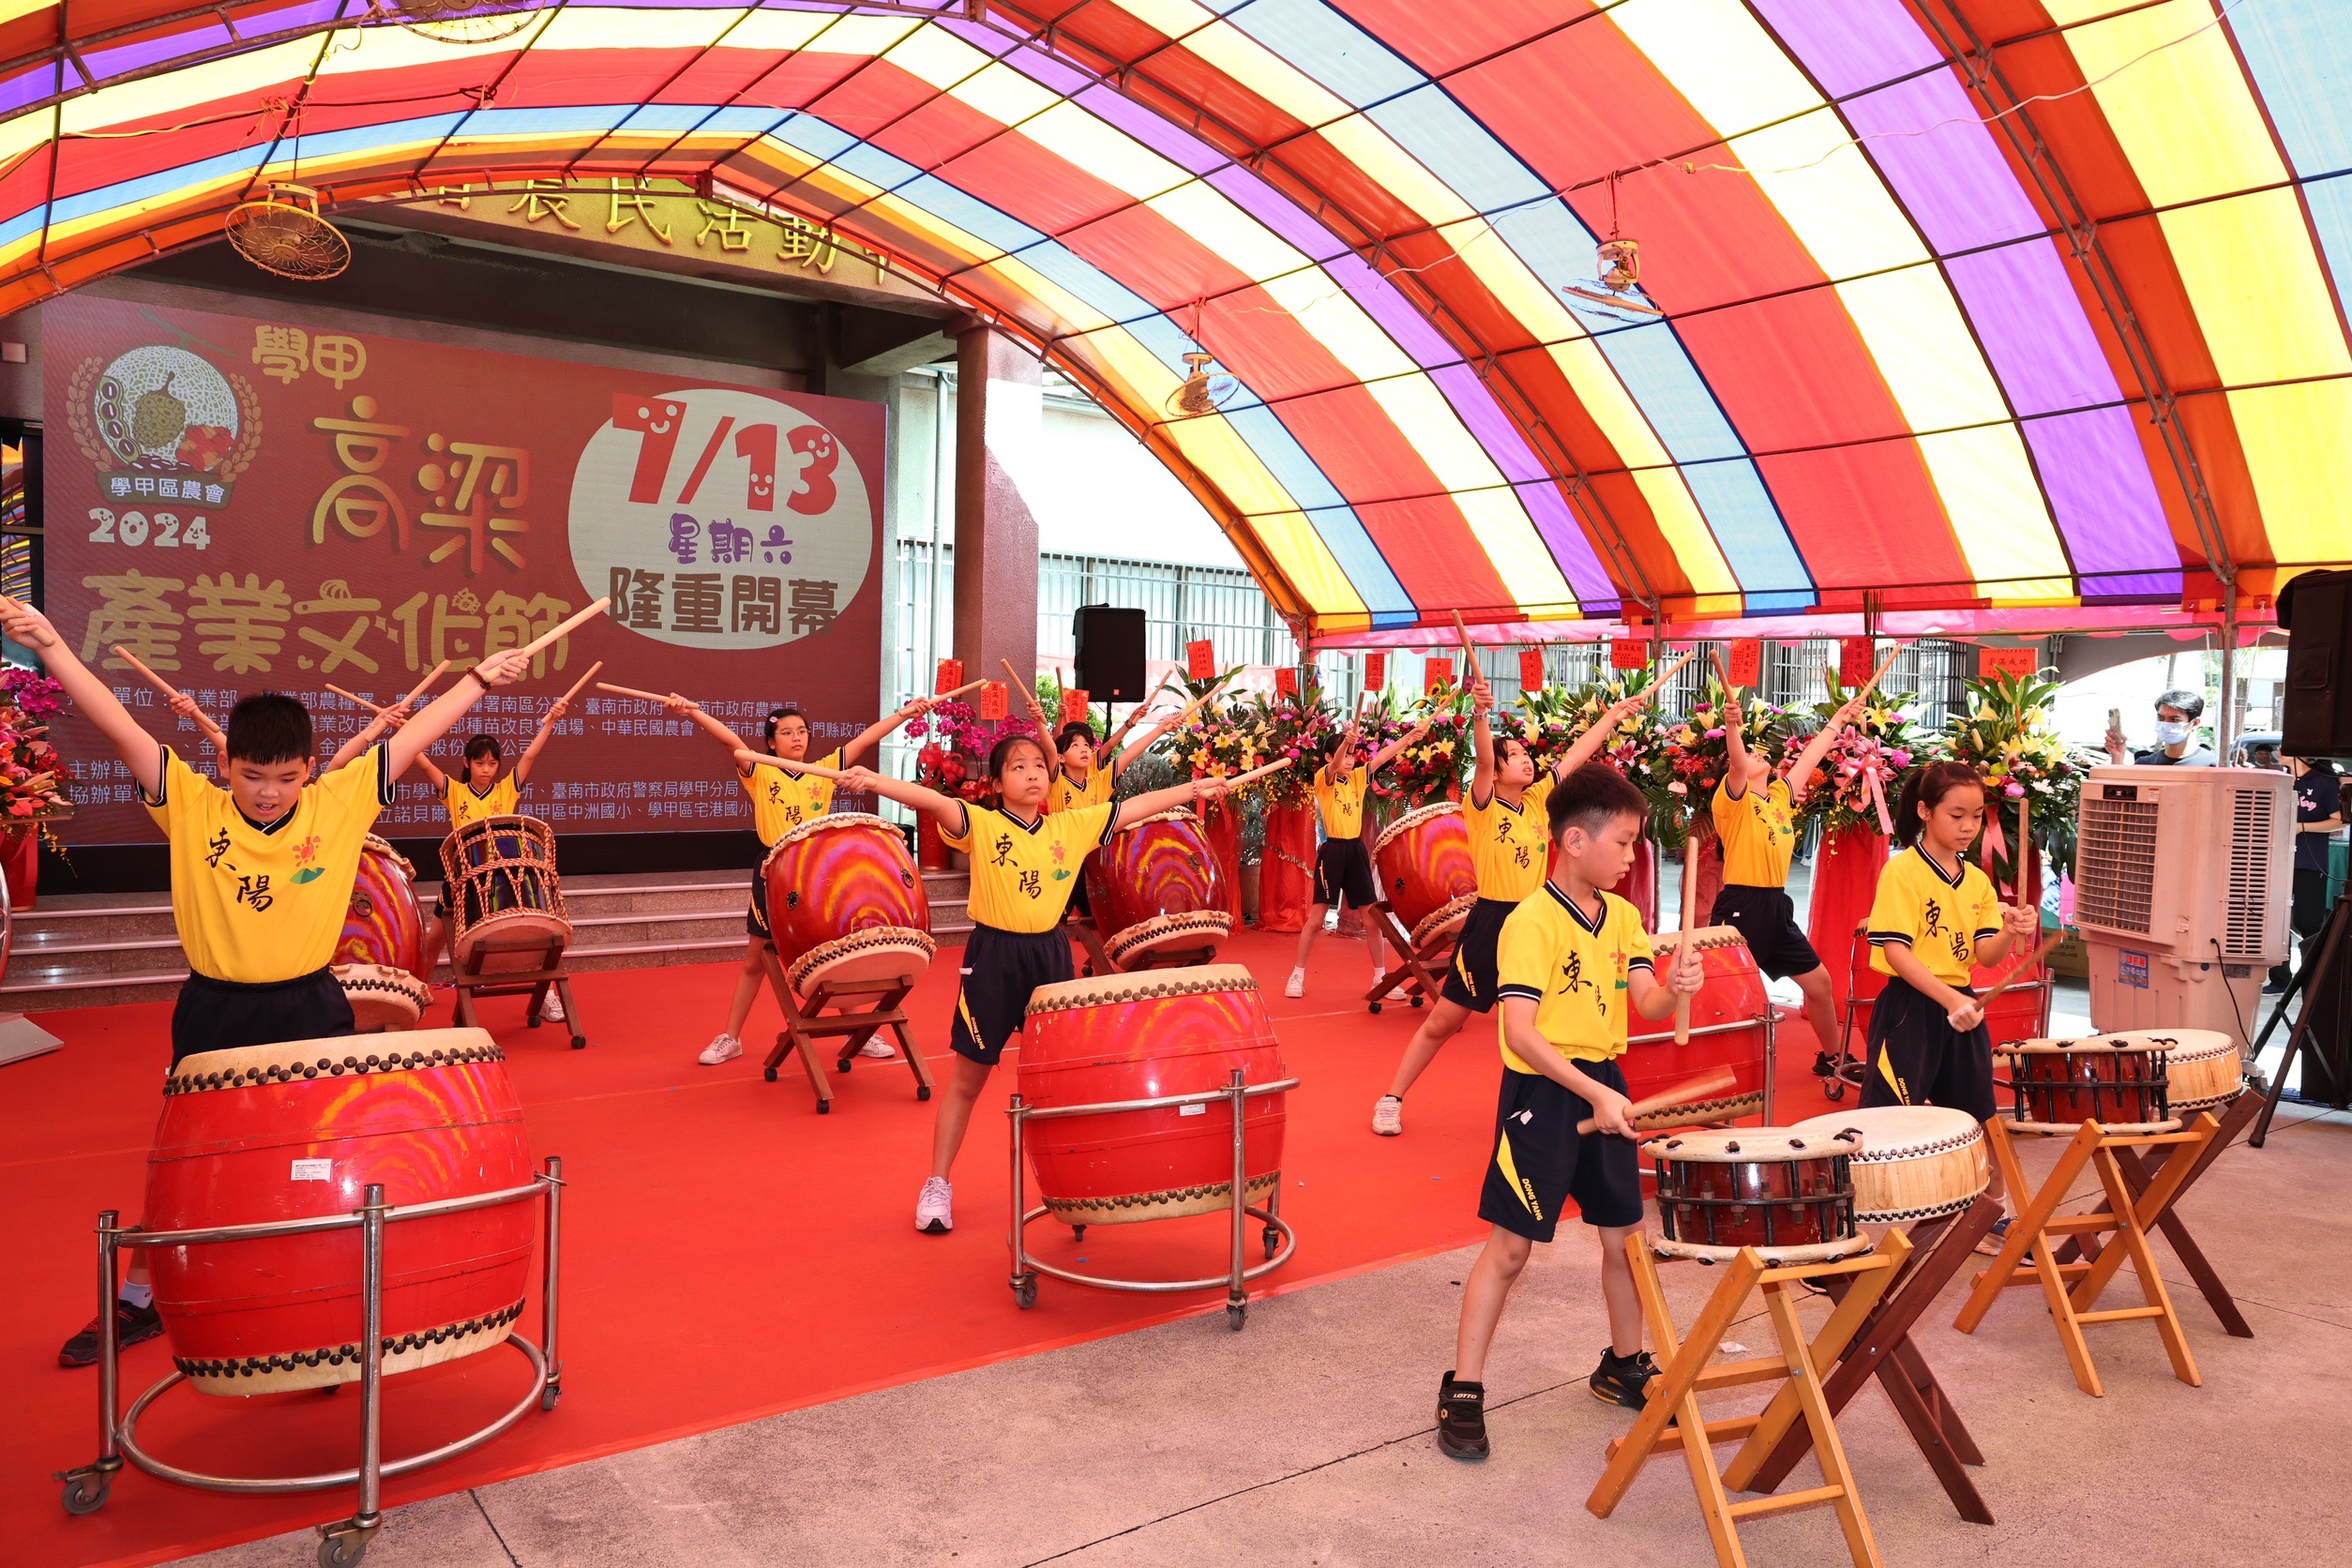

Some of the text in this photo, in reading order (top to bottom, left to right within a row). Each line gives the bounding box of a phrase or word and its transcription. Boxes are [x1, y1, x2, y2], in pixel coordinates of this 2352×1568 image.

[252, 324, 367, 390] 學甲
[611, 393, 839, 516] 7/13
[110, 476, 225, 504] 學甲區農會
[88, 508, 211, 550] 2024
[668, 512, 793, 565] 星期六
[82, 568, 571, 683] 產業文化節
[609, 565, 838, 637] 隆重開幕
[1521, 1178, 1544, 1221] DONG YANG
